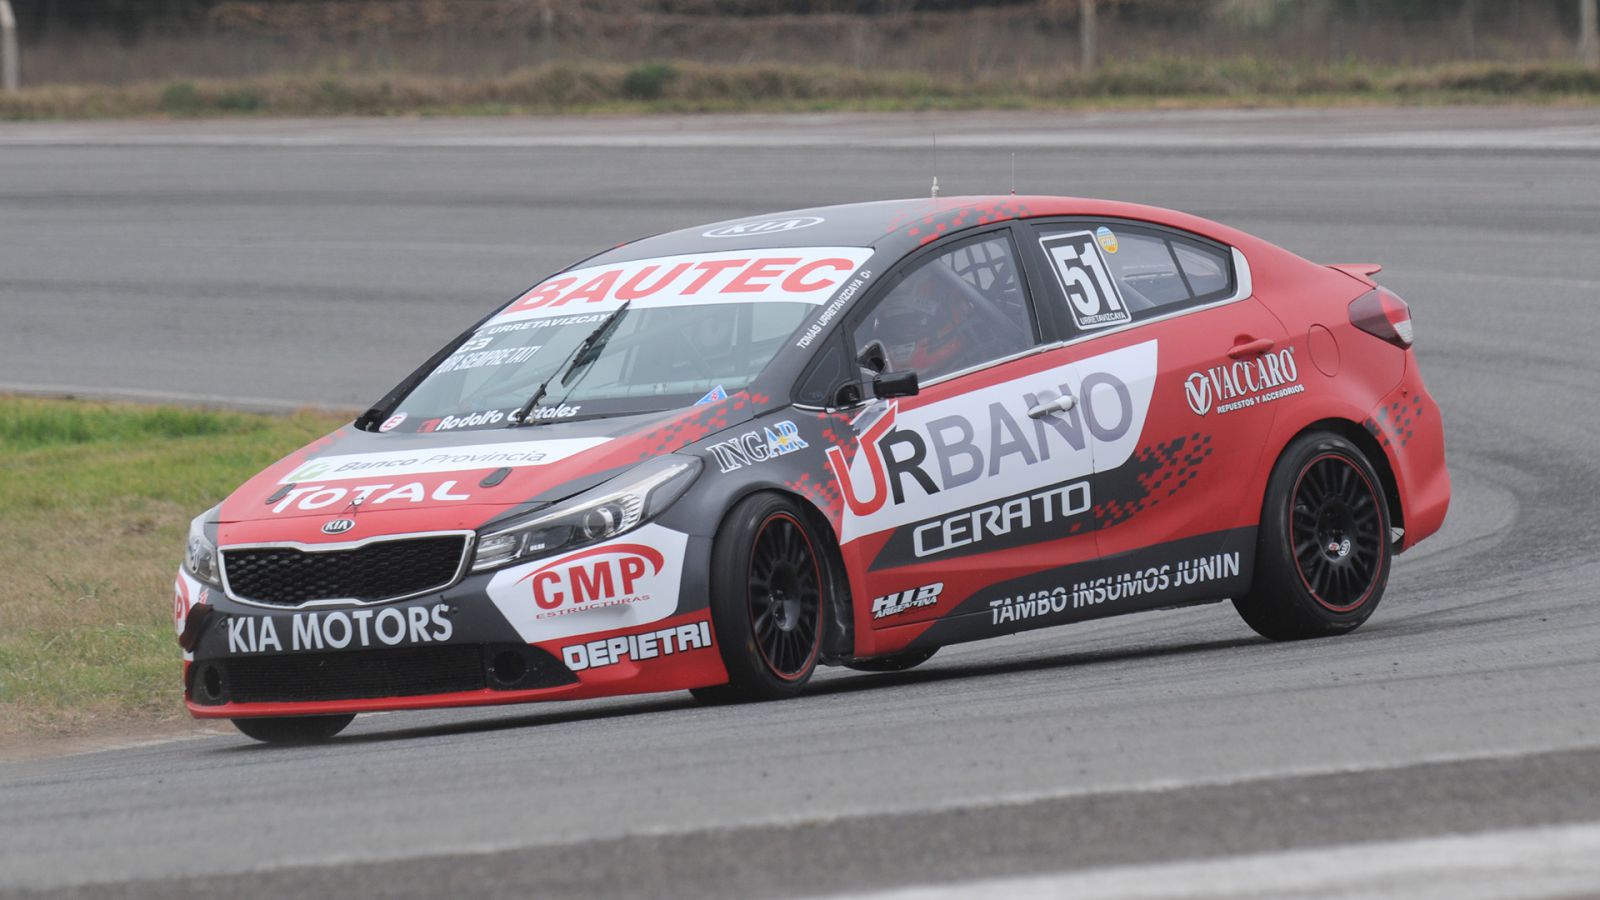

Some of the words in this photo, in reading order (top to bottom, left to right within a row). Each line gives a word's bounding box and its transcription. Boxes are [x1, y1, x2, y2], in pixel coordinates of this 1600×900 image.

[718, 218, 801, 235] KIA
[500, 257, 855, 316] BAUTEC
[817, 279, 864, 327] URRETAVIZCAYA
[1050, 242, 1121, 316] 51
[1080, 311, 1127, 325] URRETAVIZCAYA
[1208, 349, 1298, 401] VACCARO
[1217, 399, 1255, 414] REPUESTOS
[1255, 396, 1261, 404] Y
[1262, 384, 1305, 402] ACCESORIOS
[435, 409, 504, 431] Rodolfo
[826, 372, 1133, 516] URBANO
[333, 455, 418, 474] Banco
[420, 449, 548, 466] Provincia
[272, 481, 471, 514] TOTAL
[913, 481, 1092, 558] CERATO
[532, 557, 646, 610] CMP
[536, 595, 650, 620] ESTRUCTURAS
[874, 596, 937, 619] ARGENTINA
[990, 590, 1067, 625] TAMBO
[1073, 564, 1170, 608] INSUMOS
[1174, 552, 1240, 587] JUNIN
[227, 616, 282, 653] KIA
[292, 604, 453, 650] MOTORS
[561, 621, 712, 672] DEPIETRI
